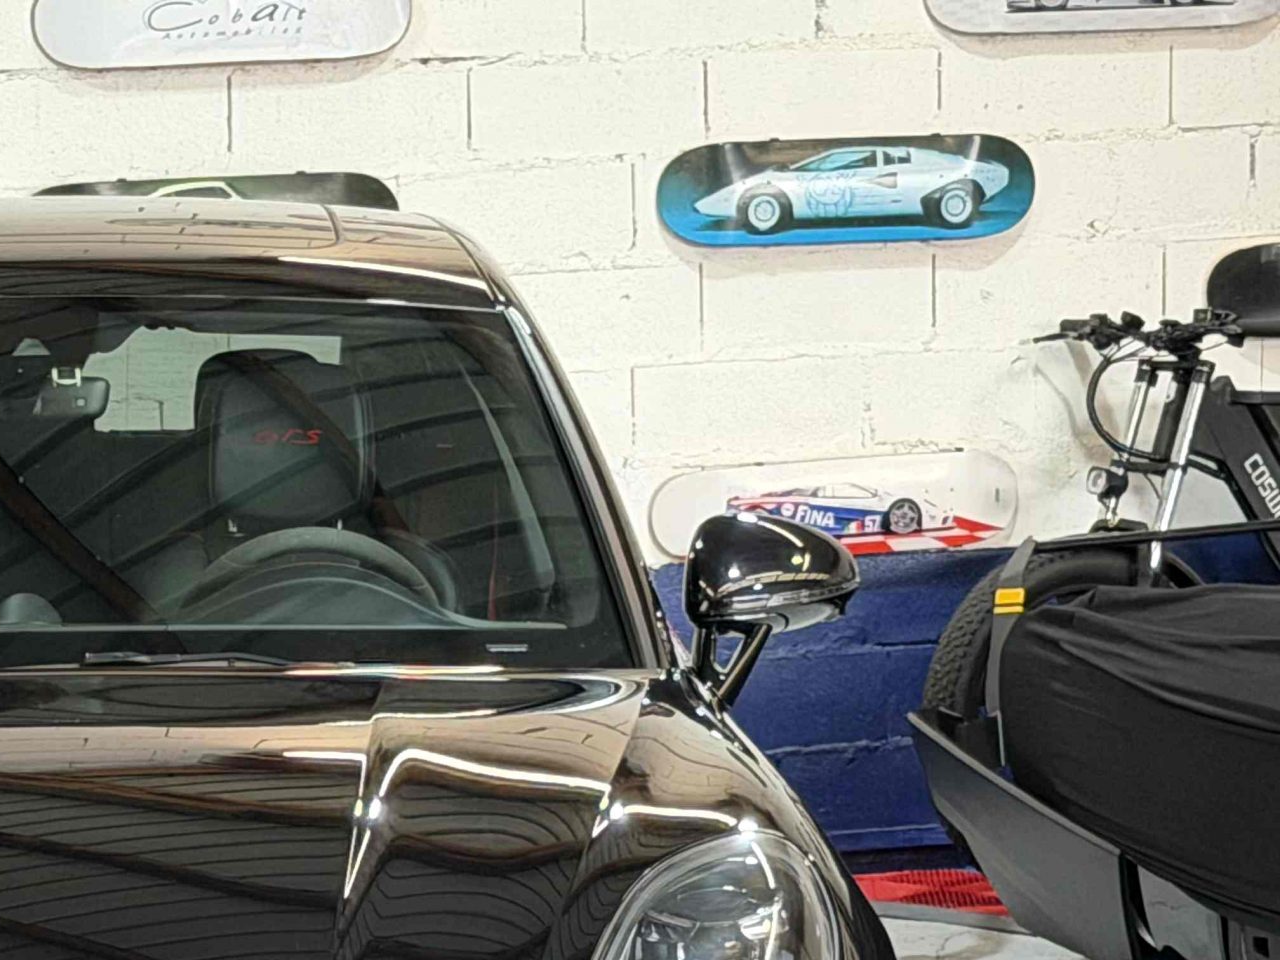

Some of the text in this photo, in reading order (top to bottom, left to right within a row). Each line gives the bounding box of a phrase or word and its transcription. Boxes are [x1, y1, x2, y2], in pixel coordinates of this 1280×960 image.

[147, 1, 306, 32] Cobalt
[1243, 453, 1280, 519] COSW
[795, 505, 836, 528] FINA
[864, 515, 882, 532] 57
